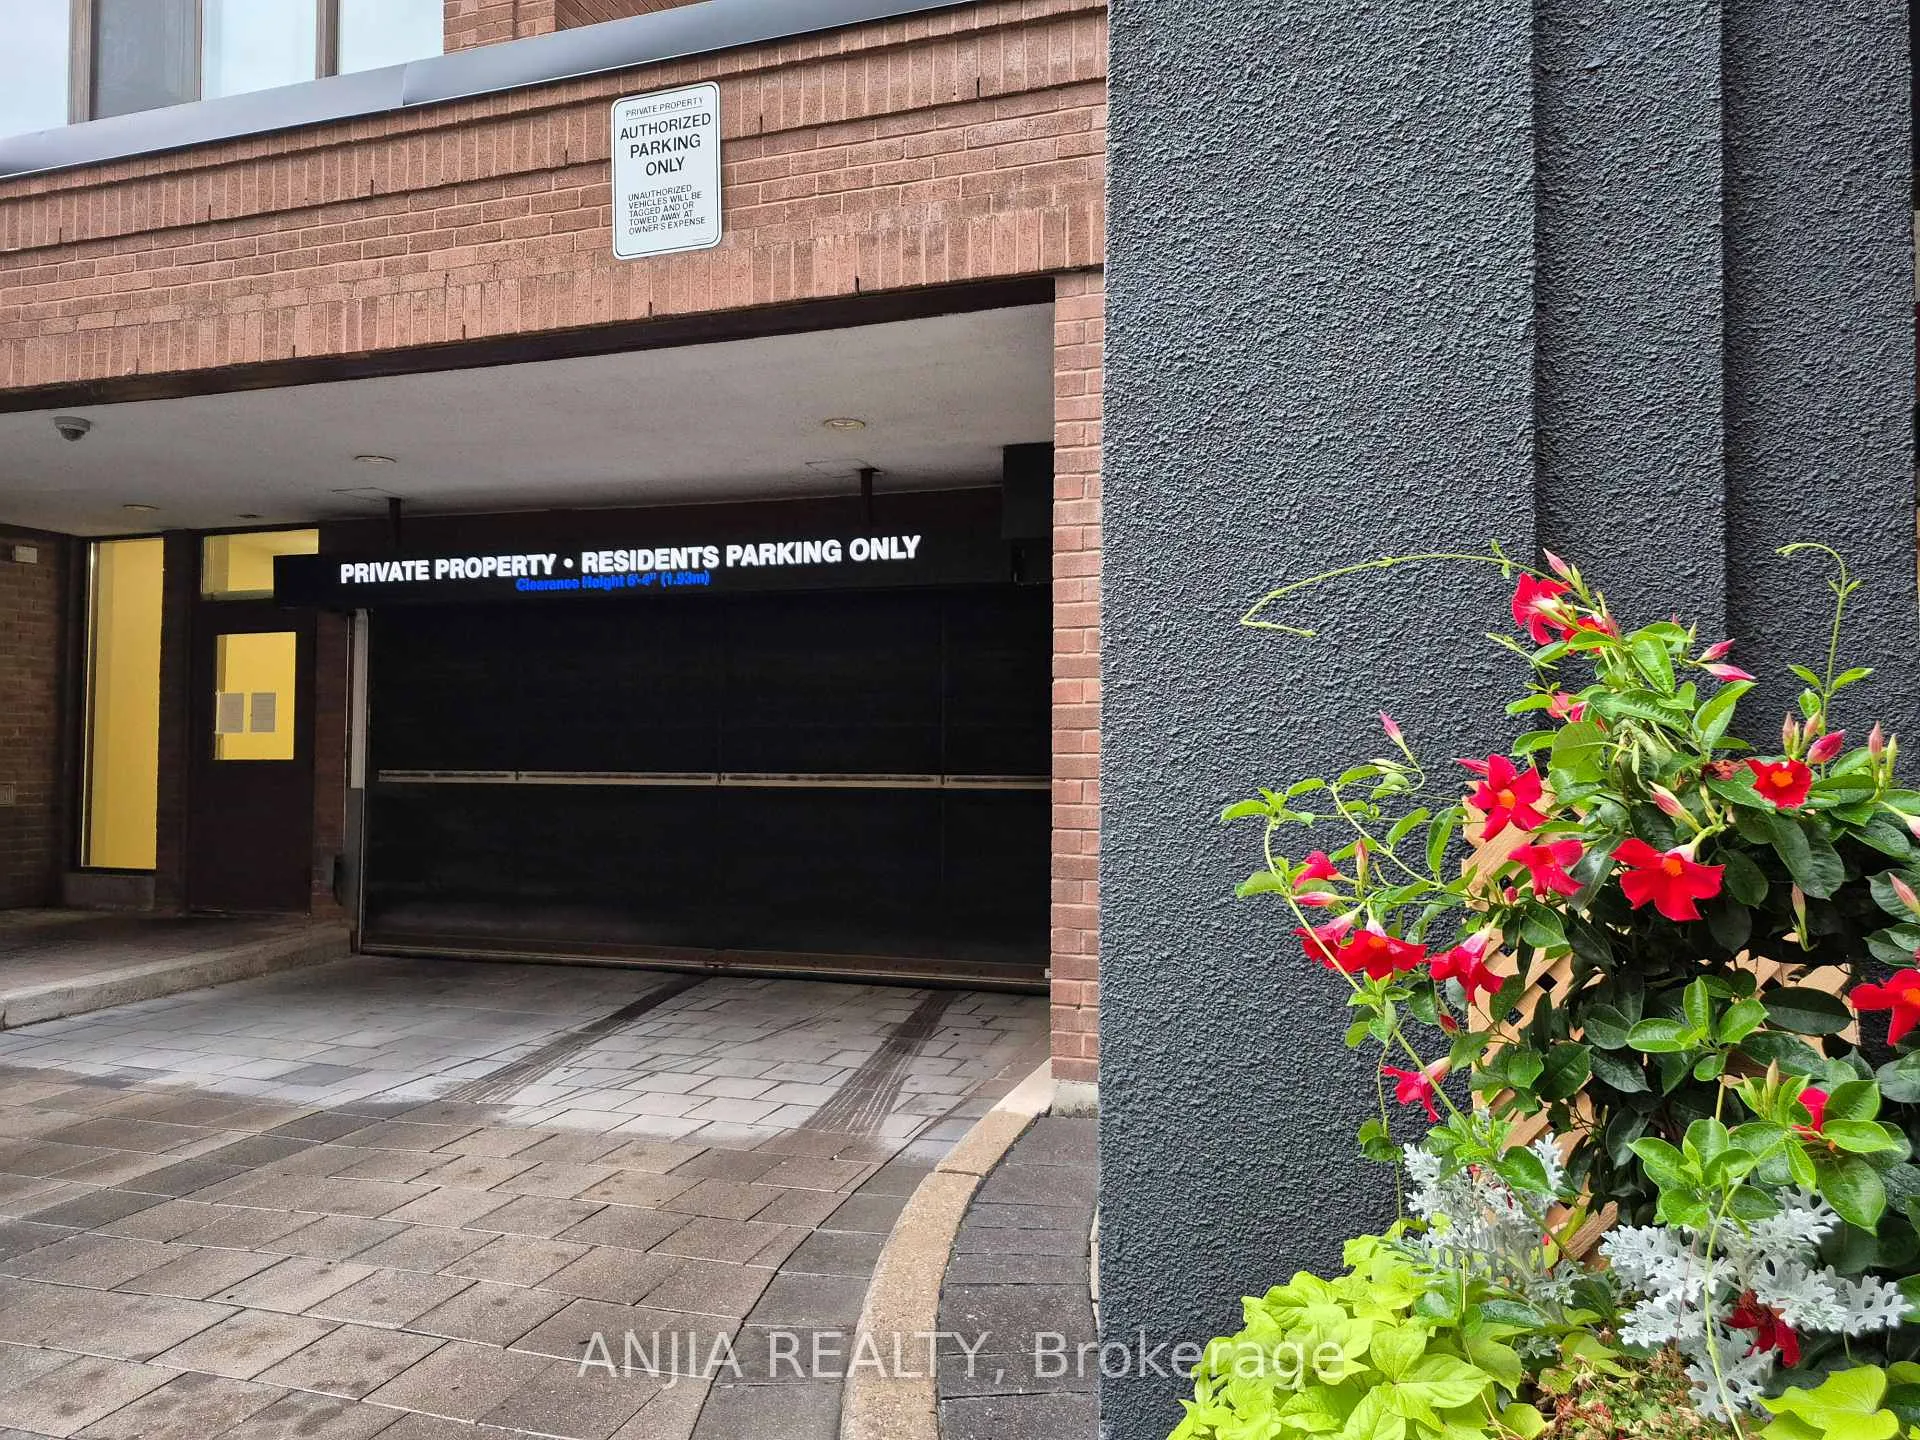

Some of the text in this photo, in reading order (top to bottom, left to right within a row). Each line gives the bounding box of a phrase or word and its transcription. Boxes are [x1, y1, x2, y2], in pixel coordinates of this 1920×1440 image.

[626, 96, 704, 117] PRIVATE PROPERTY
[620, 113, 711, 140] AUTHORIZED
[630, 134, 701, 159] PARKING
[646, 156, 685, 176] ONLY
[628, 184, 692, 202] UNAUTHORIZED
[628, 190, 703, 209] VEHICLES WILL BE
[629, 200, 694, 218] TAGGED AND OR
[629, 209, 693, 226] TOWED AWAY AT
[667, 216, 705, 229] EXPENSE
[340, 535, 921, 584] PRIVATE PROPERTY RESIDENTS PARKING ONLY
[515, 577, 580, 592] Clearance
[582, 574, 624, 591] Height
